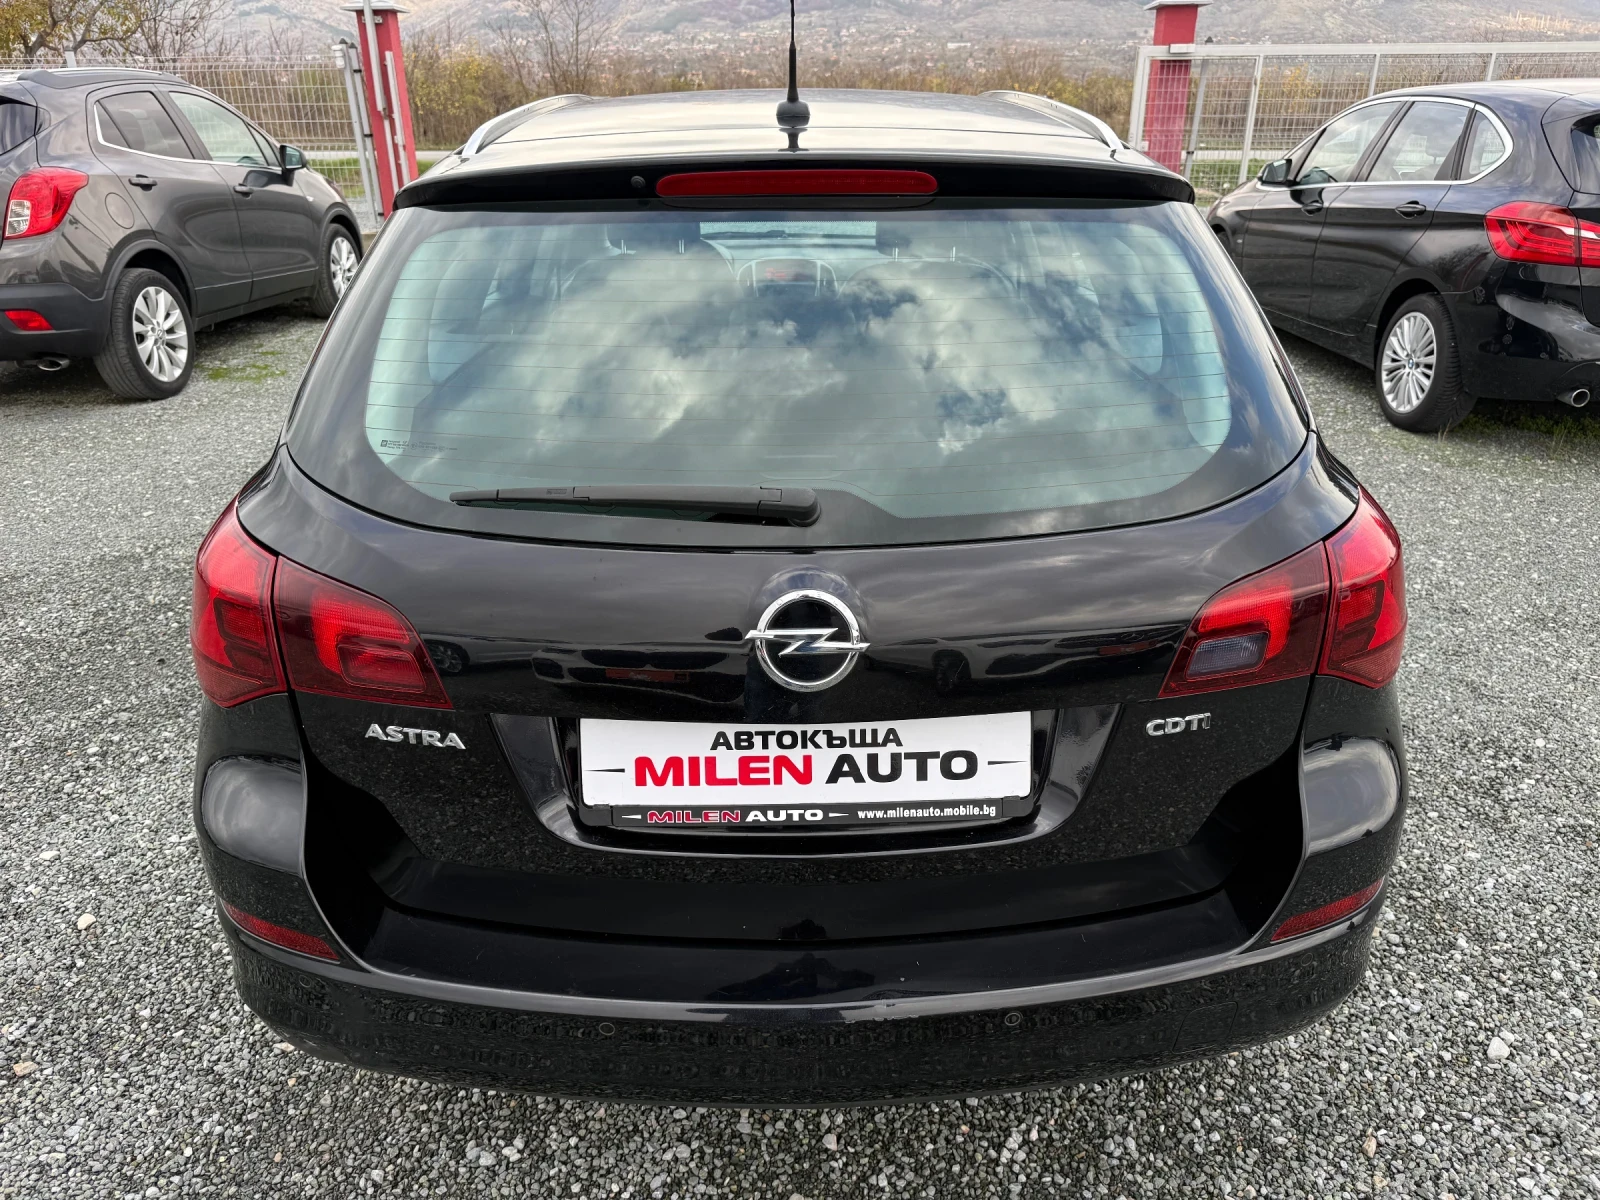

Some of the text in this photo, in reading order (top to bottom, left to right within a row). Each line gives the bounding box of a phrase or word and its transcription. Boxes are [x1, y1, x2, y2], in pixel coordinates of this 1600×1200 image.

[1146, 712, 1211, 736] CDTI
[364, 723, 466, 749] ASTRA
[710, 728, 903, 750] АВТОКЪЩА
[635, 750, 978, 787] MILEN AUTO
[647, 809, 824, 824] MILEN AUTO
[858, 804, 996, 818] www.milenauto.mobile.bg
